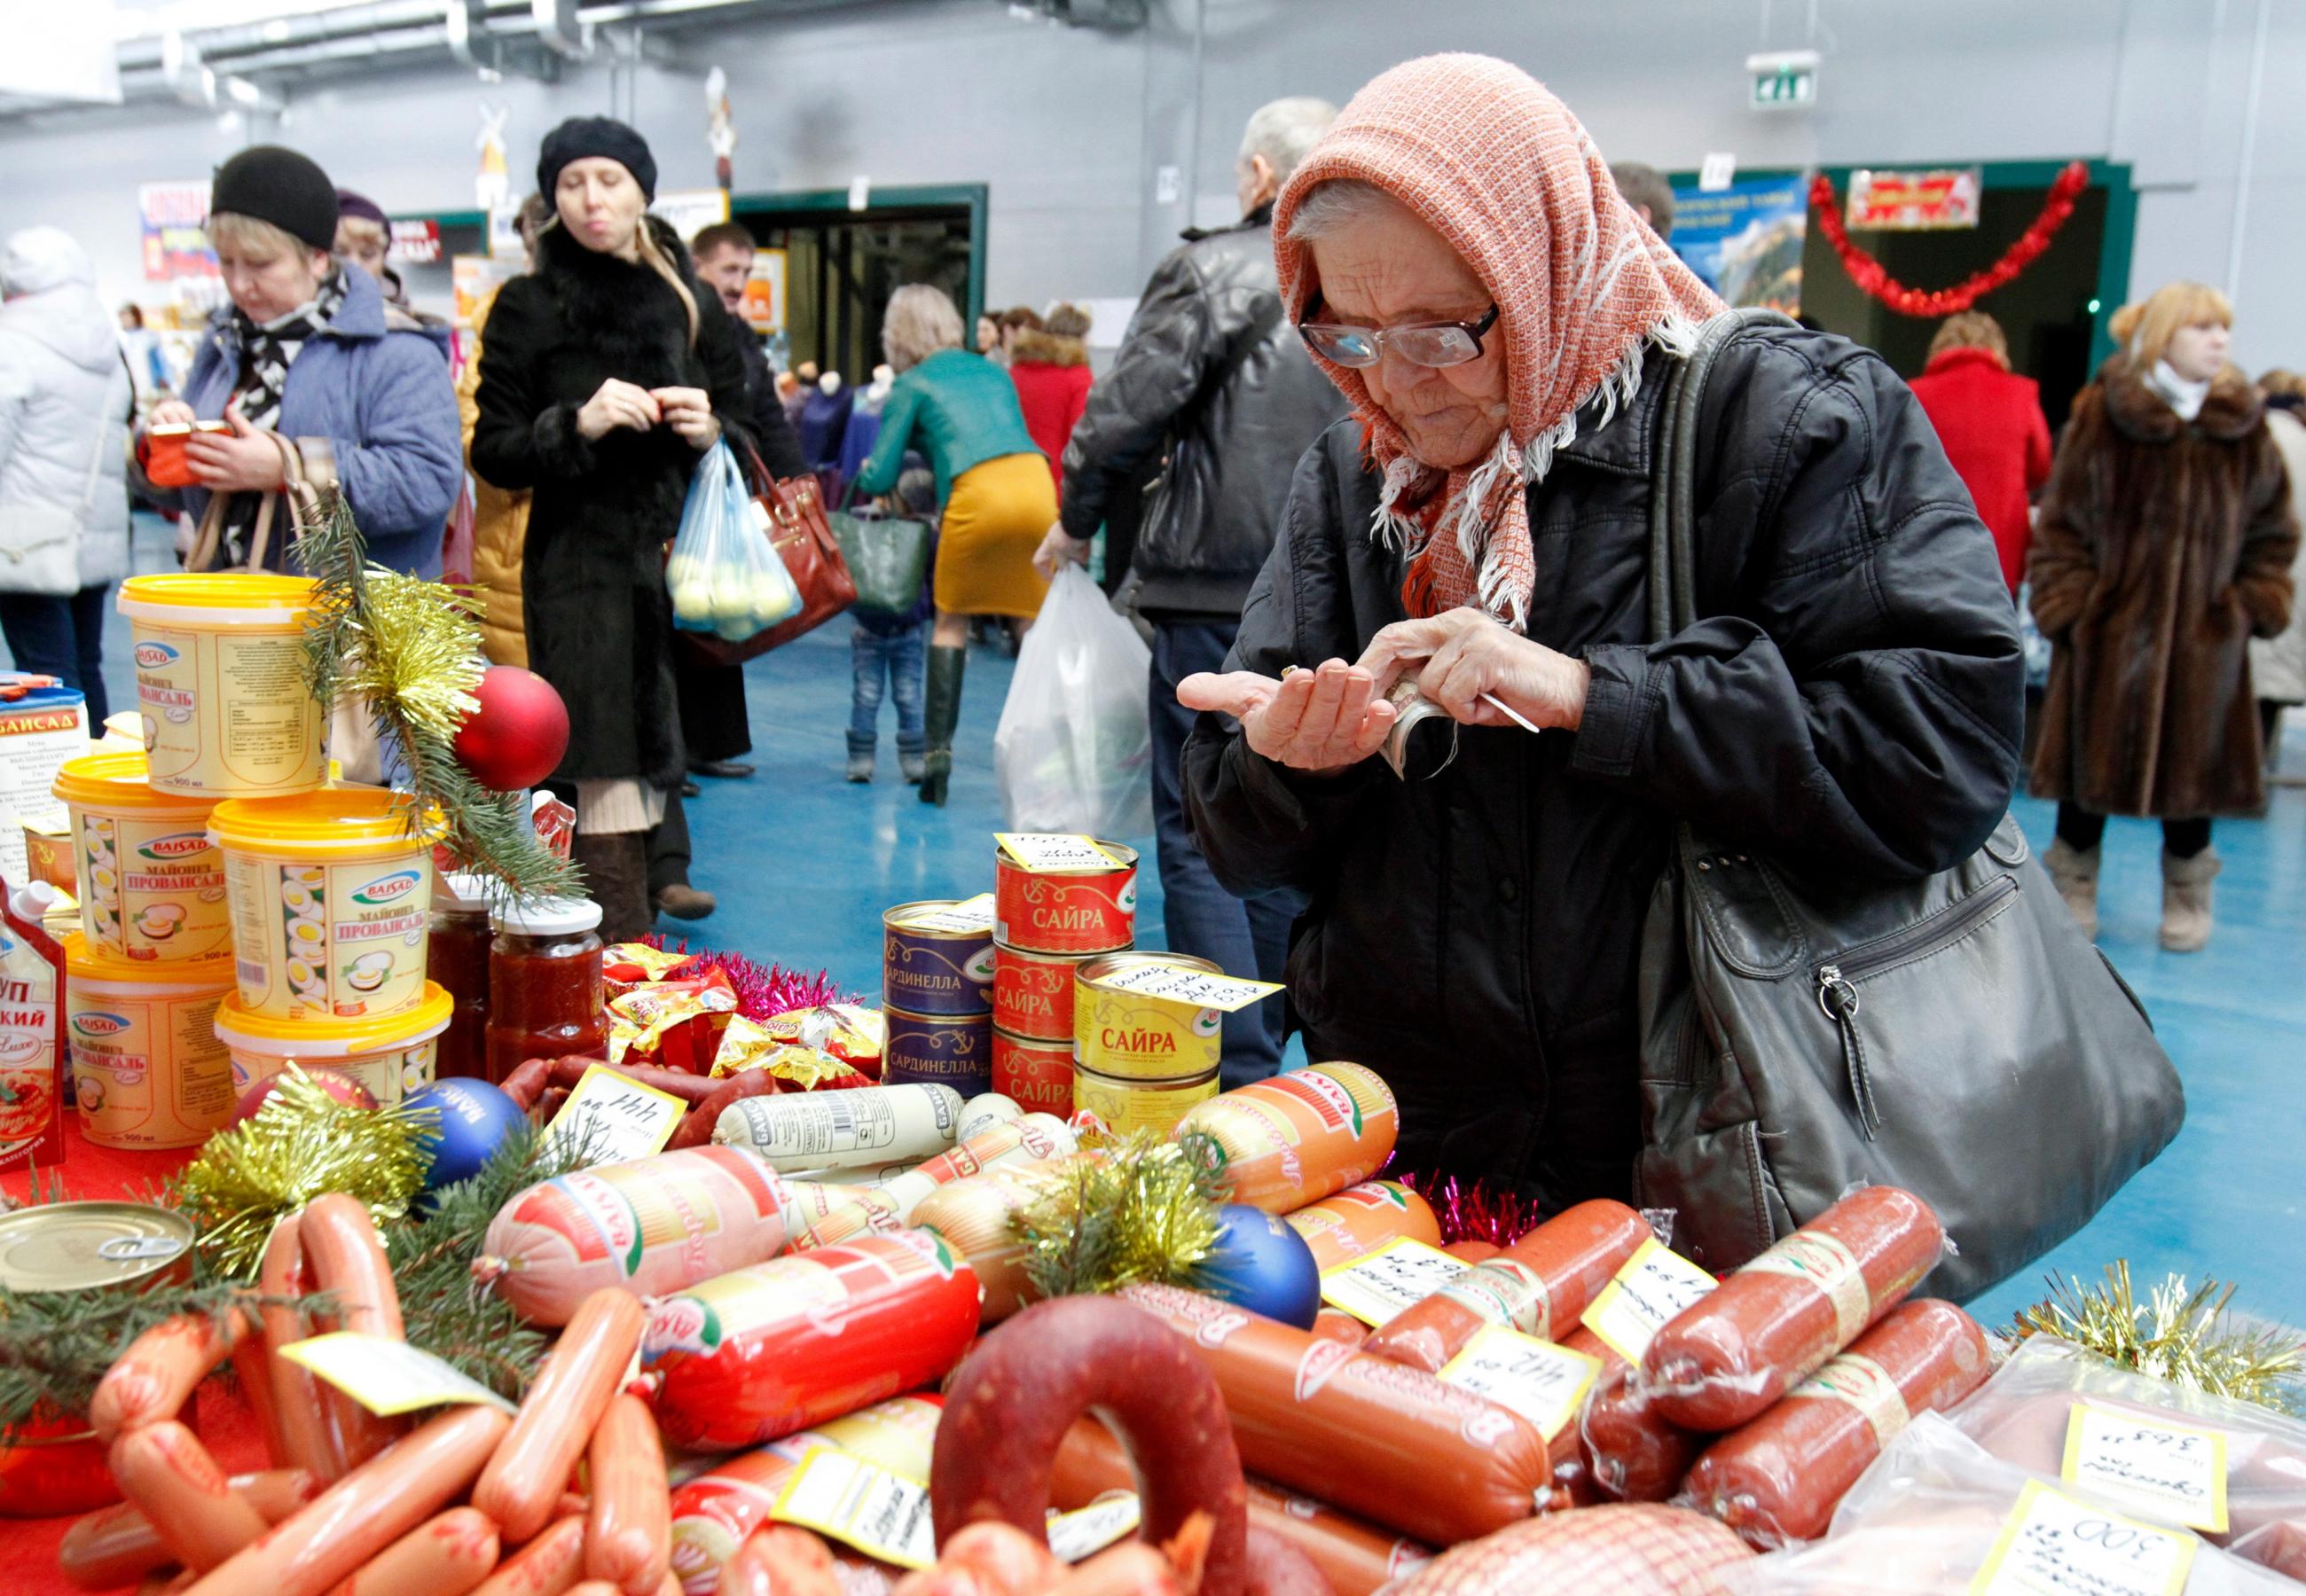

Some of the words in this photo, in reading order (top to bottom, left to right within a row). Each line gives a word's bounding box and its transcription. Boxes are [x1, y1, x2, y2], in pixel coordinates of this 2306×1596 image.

[366, 878, 414, 896] BAISAD
[1032, 904, 1106, 930] САЙРА
[996, 985, 1055, 1017] САЙРА
[1102, 1027, 1178, 1053] САЙРА
[890, 1051, 977, 1076] САРДИНЕЛЛА
